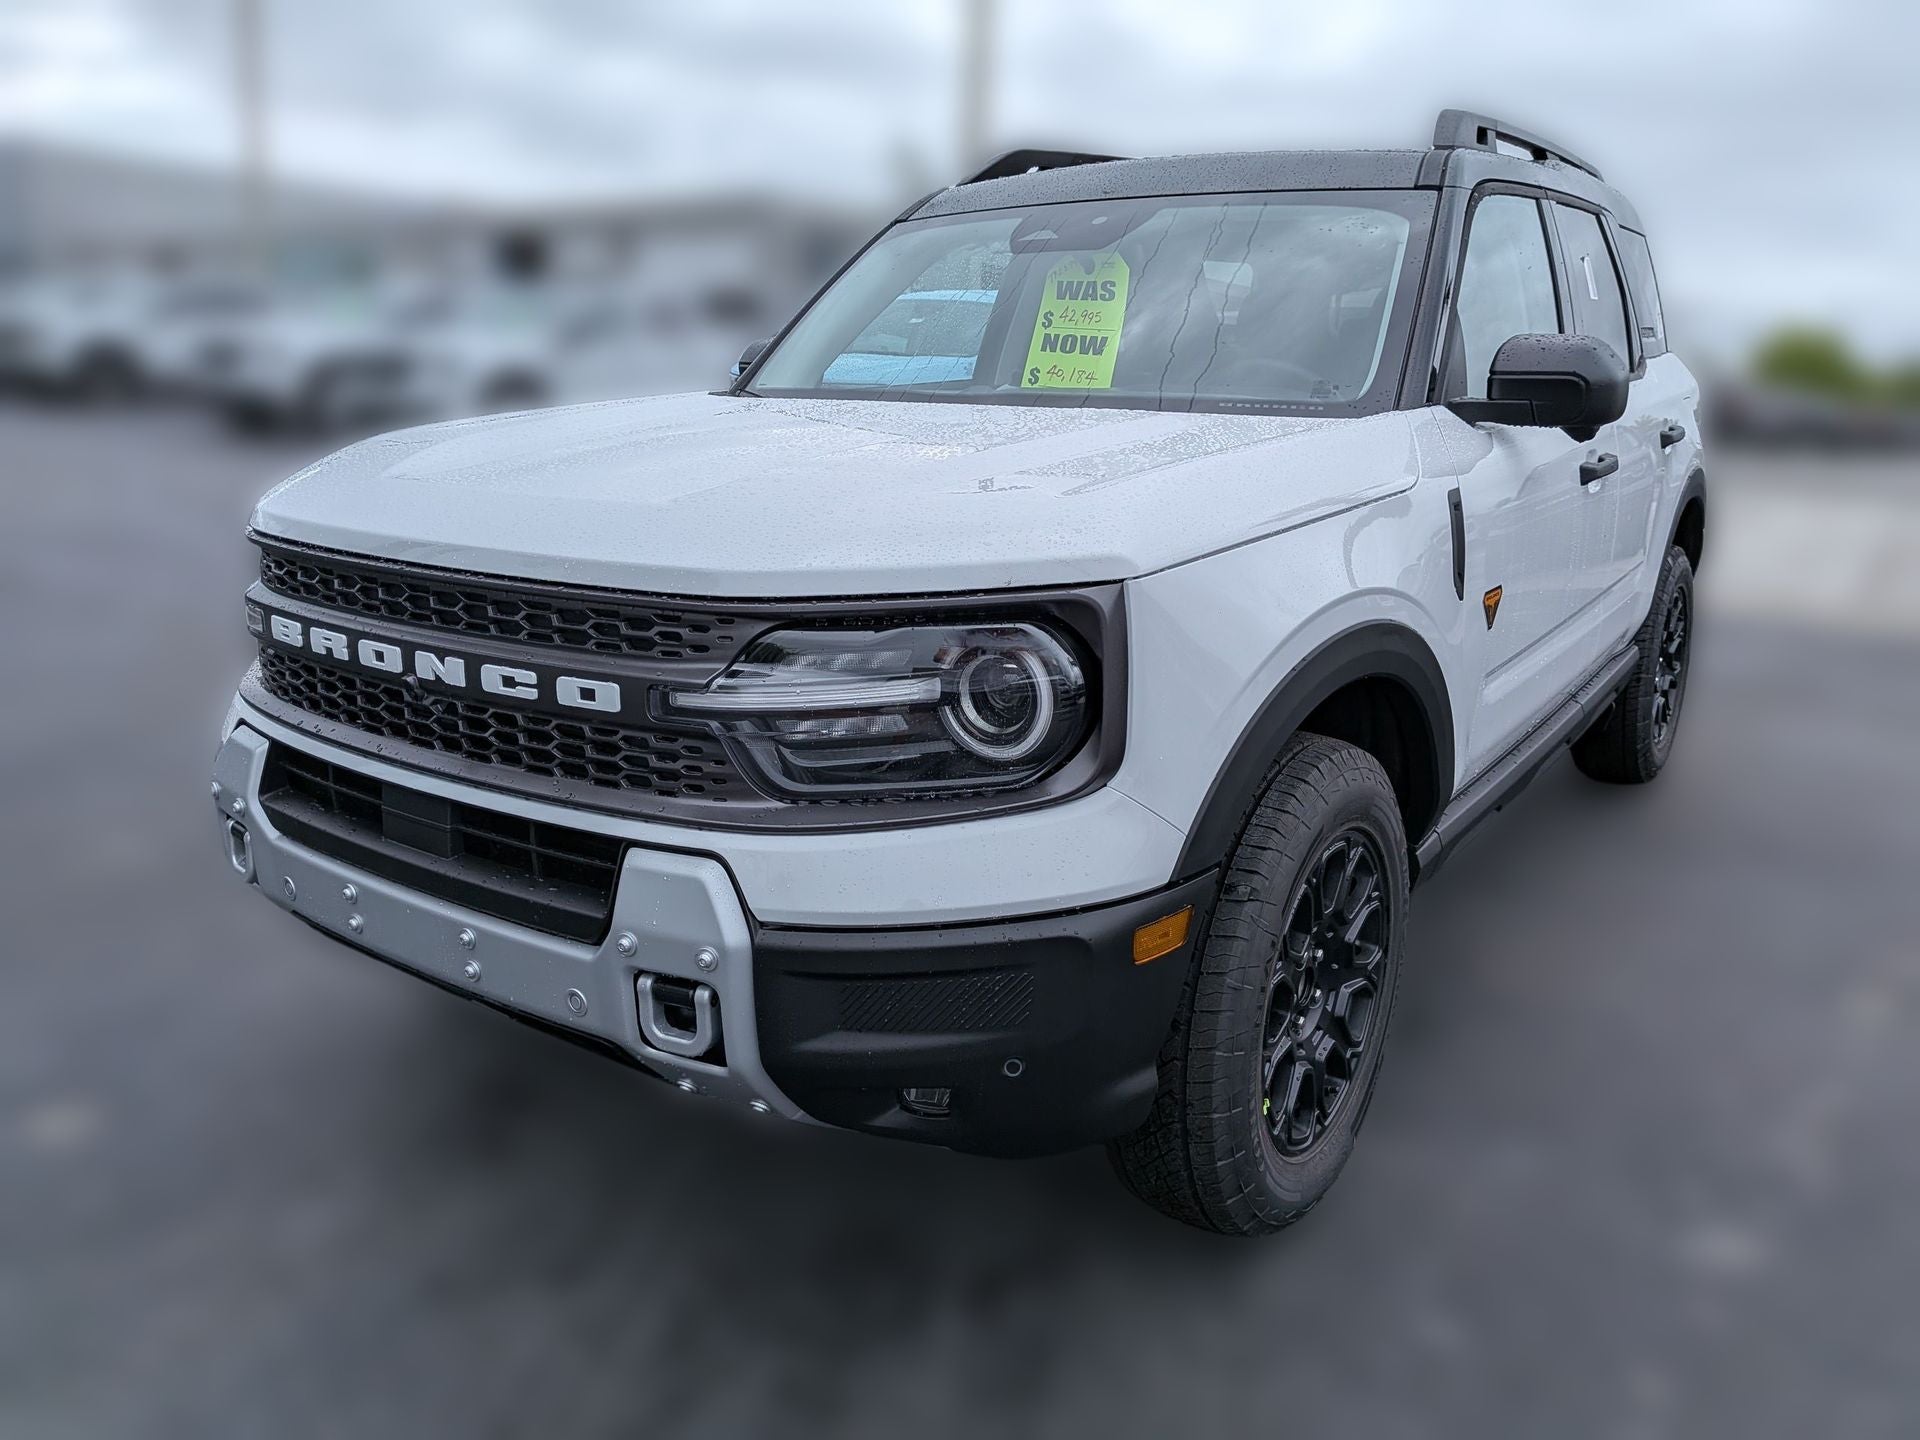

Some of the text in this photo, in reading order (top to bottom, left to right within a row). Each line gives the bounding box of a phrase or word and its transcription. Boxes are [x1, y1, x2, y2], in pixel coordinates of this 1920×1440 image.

[1056, 280, 1117, 301] WAS
[1041, 306, 1102, 329] $ 42,995
[1040, 333, 1109, 356] NOW
[1027, 364, 1098, 386] $ 40,184
[271, 615, 621, 713] BRONCO
